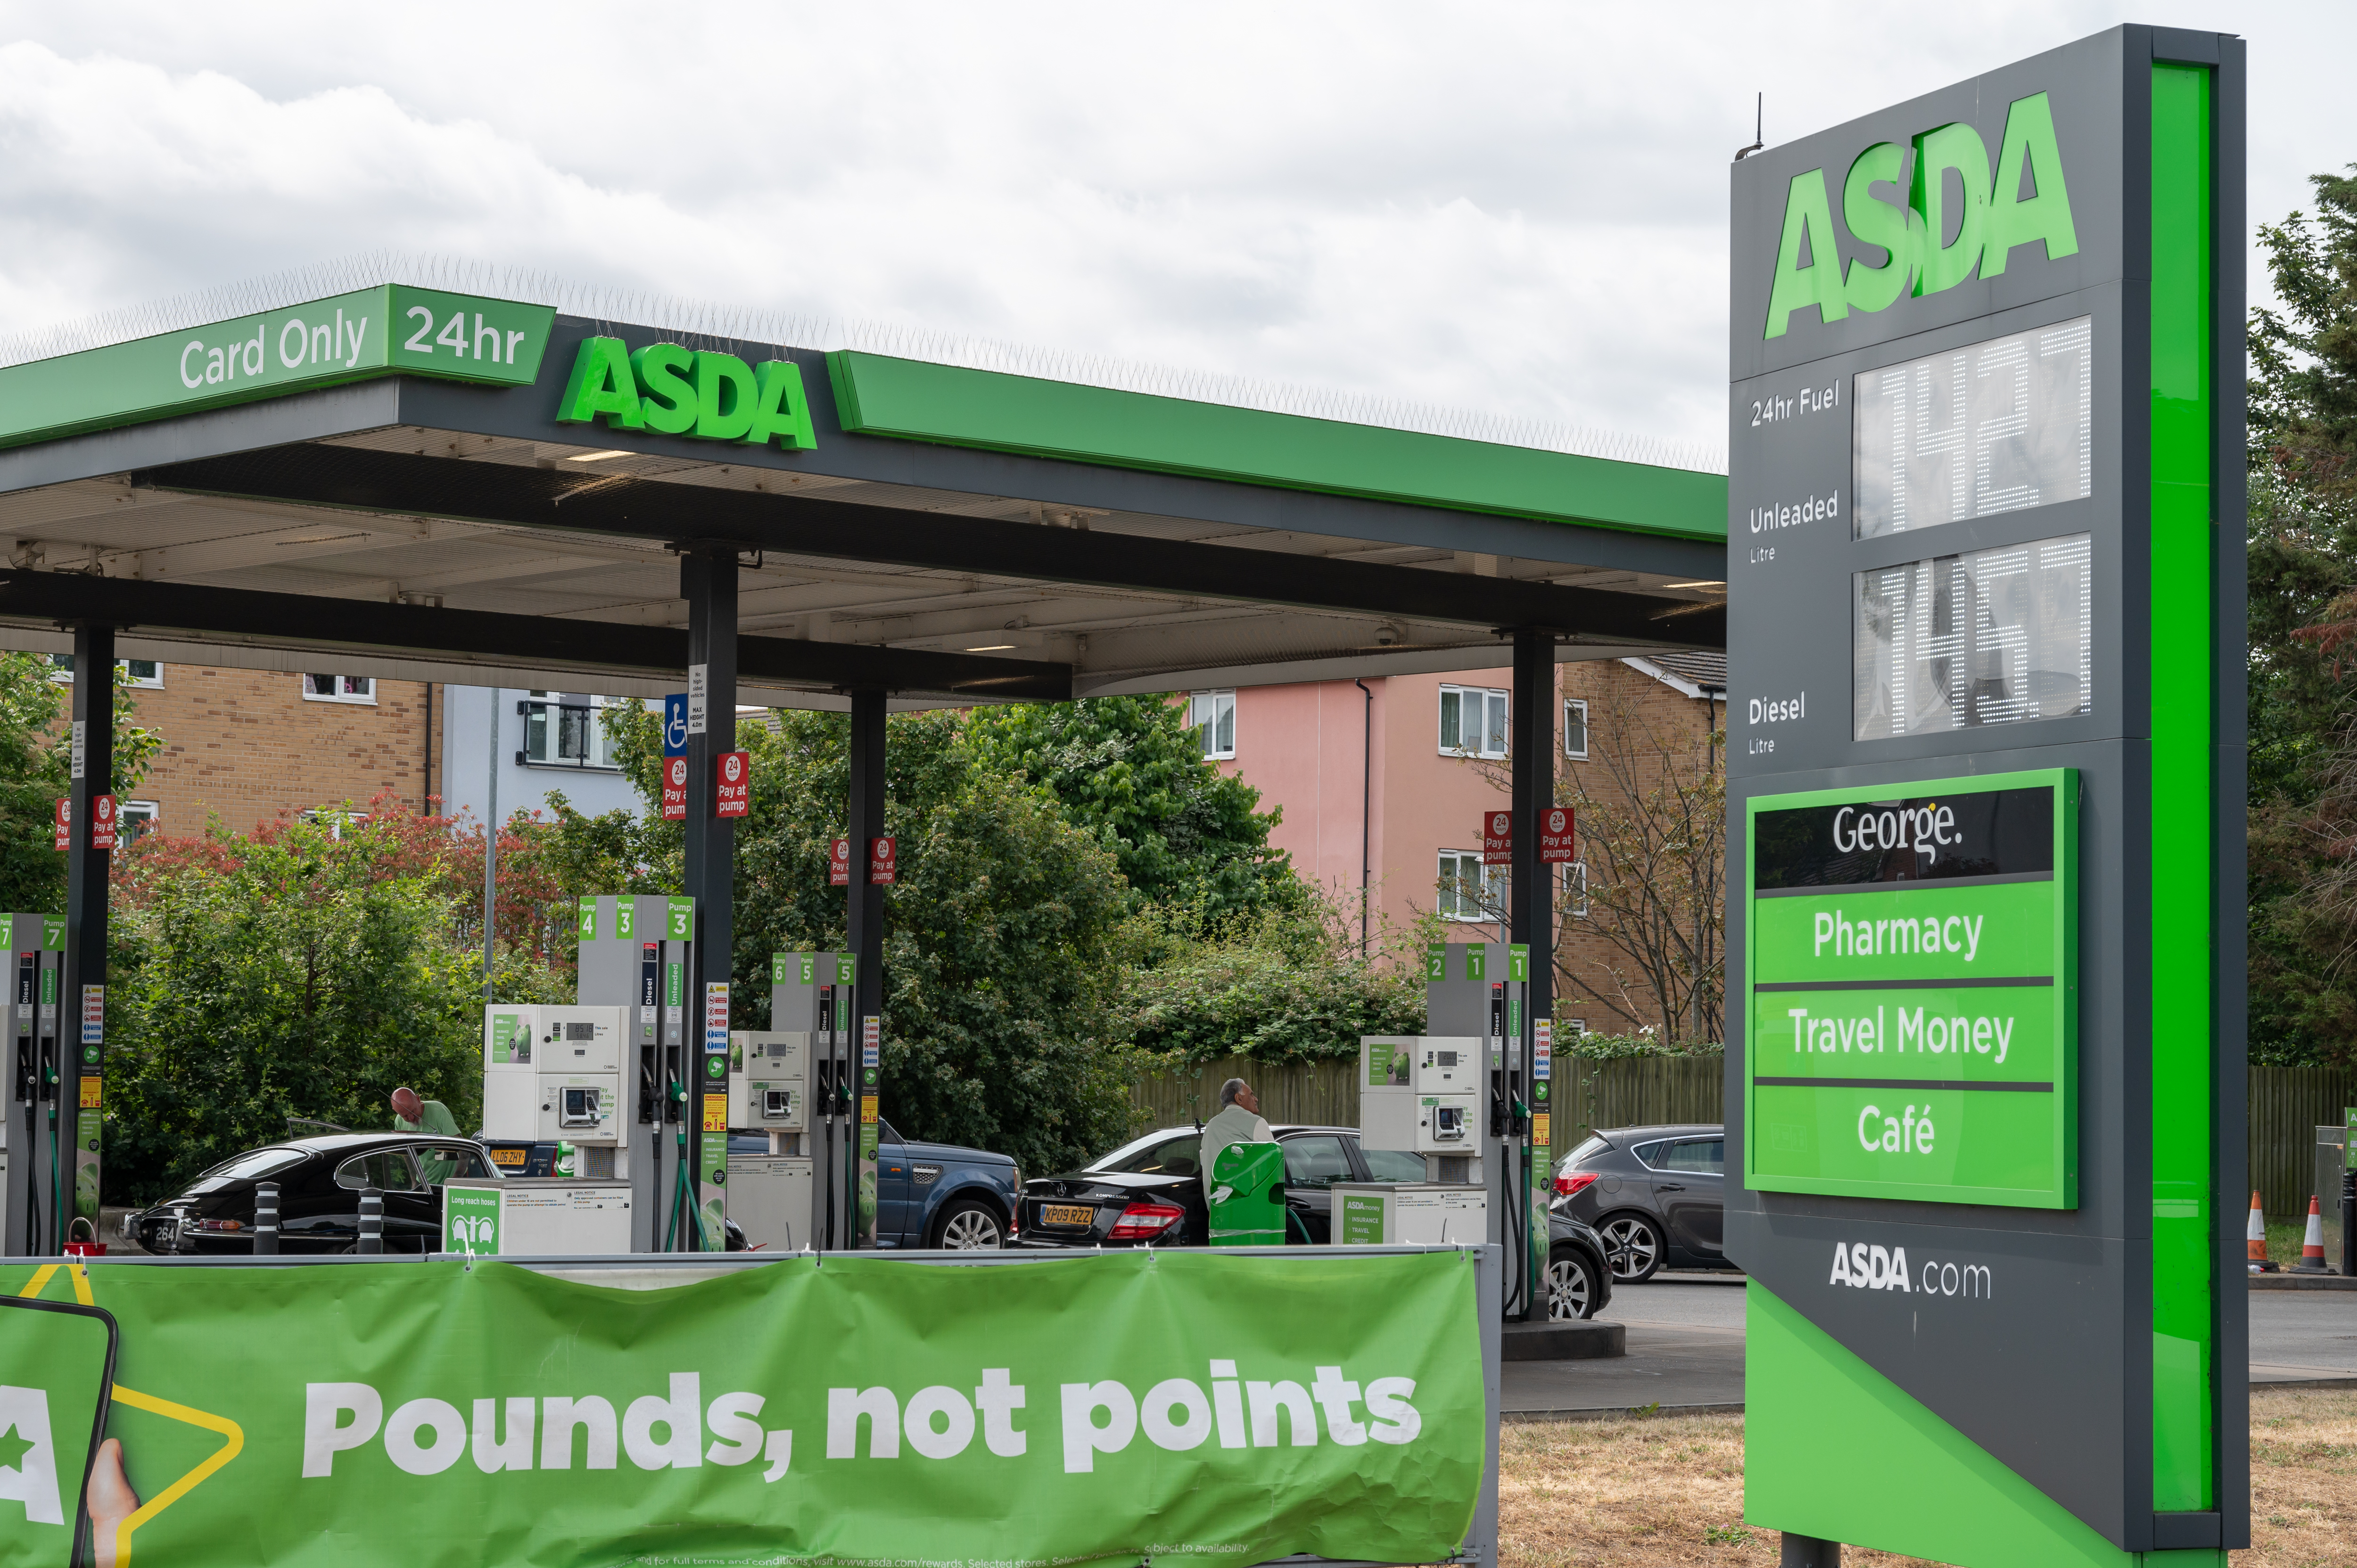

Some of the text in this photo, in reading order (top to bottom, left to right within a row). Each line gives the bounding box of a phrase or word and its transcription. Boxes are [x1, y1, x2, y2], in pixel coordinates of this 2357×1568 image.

[1764, 90, 2079, 340] ASDA
[180, 306, 524, 389] Card Only 24hr
[556, 336, 818, 451] ASDA
[1750, 379, 1839, 427] 24hr Fuel
[1750, 490, 1838, 534] Unleaded
[1750, 544, 1776, 564] Litre
[1749, 691, 1805, 725] Diesel
[1749, 738, 1774, 755] Litre
[675, 765, 684, 775] 24
[728, 760, 738, 771] 24
[665, 789, 681, 802] Pay
[719, 784, 746, 798] Pay at
[64, 805, 70, 813] 24
[101, 802, 108, 810] 24
[665, 805, 684, 817] pum
[719, 801, 745, 813] pump
[1496, 818, 1506, 826] 24
[1553, 815, 1563, 823] 24
[57, 824, 68, 835] Pay
[94, 821, 114, 833] Pay at
[57, 838, 70, 847] pum
[94, 835, 113, 846] pump
[1486, 838, 1503, 849] Pay
[1543, 835, 1571, 847] Pay at
[1543, 849, 1571, 860] pump
[832, 862, 844, 871] Pay
[873, 861, 893, 870] Pay at
[833, 874, 849, 882] pum
[873, 872, 892, 881] pump
[580, 904, 596, 912] Pump
[618, 902, 634, 911] Pump
[669, 903, 692, 912] Pump
[583, 914, 593, 934] 4
[621, 913, 630, 933] 3
[674, 914, 686, 934] 3
[2, 928, 9, 944] 7
[49, 929, 60, 945] 7
[1814, 910, 1984, 961] Pharmacy
[1510, 950, 1526, 958] Pump
[775, 966, 783, 980] 6
[804, 965, 810, 980] 5
[841, 966, 850, 980] 5
[1432, 959, 1441, 976] 2
[1473, 958, 1479, 975] 1
[1516, 959, 1521, 976] 1
[1788, 1005, 2014, 1064] Travel Money
[1858, 1104, 1935, 1155] Café
[509, 1152, 522, 1163] ZHY
[452, 1196, 464, 1205] Long
[1045, 1208, 1090, 1223] KP09 RZZ
[156, 1227, 174, 1240] 264
[1829, 1242, 1990, 1299] ASDA.com
[302, 1358, 1422, 1484] Pounds, not points
[635, 1557, 651, 1565] and
[654, 1557, 670, 1566] for
[752, 1556, 810, 1567] conditions,
[814, 1557, 833, 1566] visit
[837, 1557, 963, 1568] www.asda.com/rewards.
[968, 1558, 1012, 1568] Selected
[1015, 1559, 1049, 1568] stores.
[1182, 1543, 1193, 1552] to
[1195, 1543, 1249, 1554] availability.
